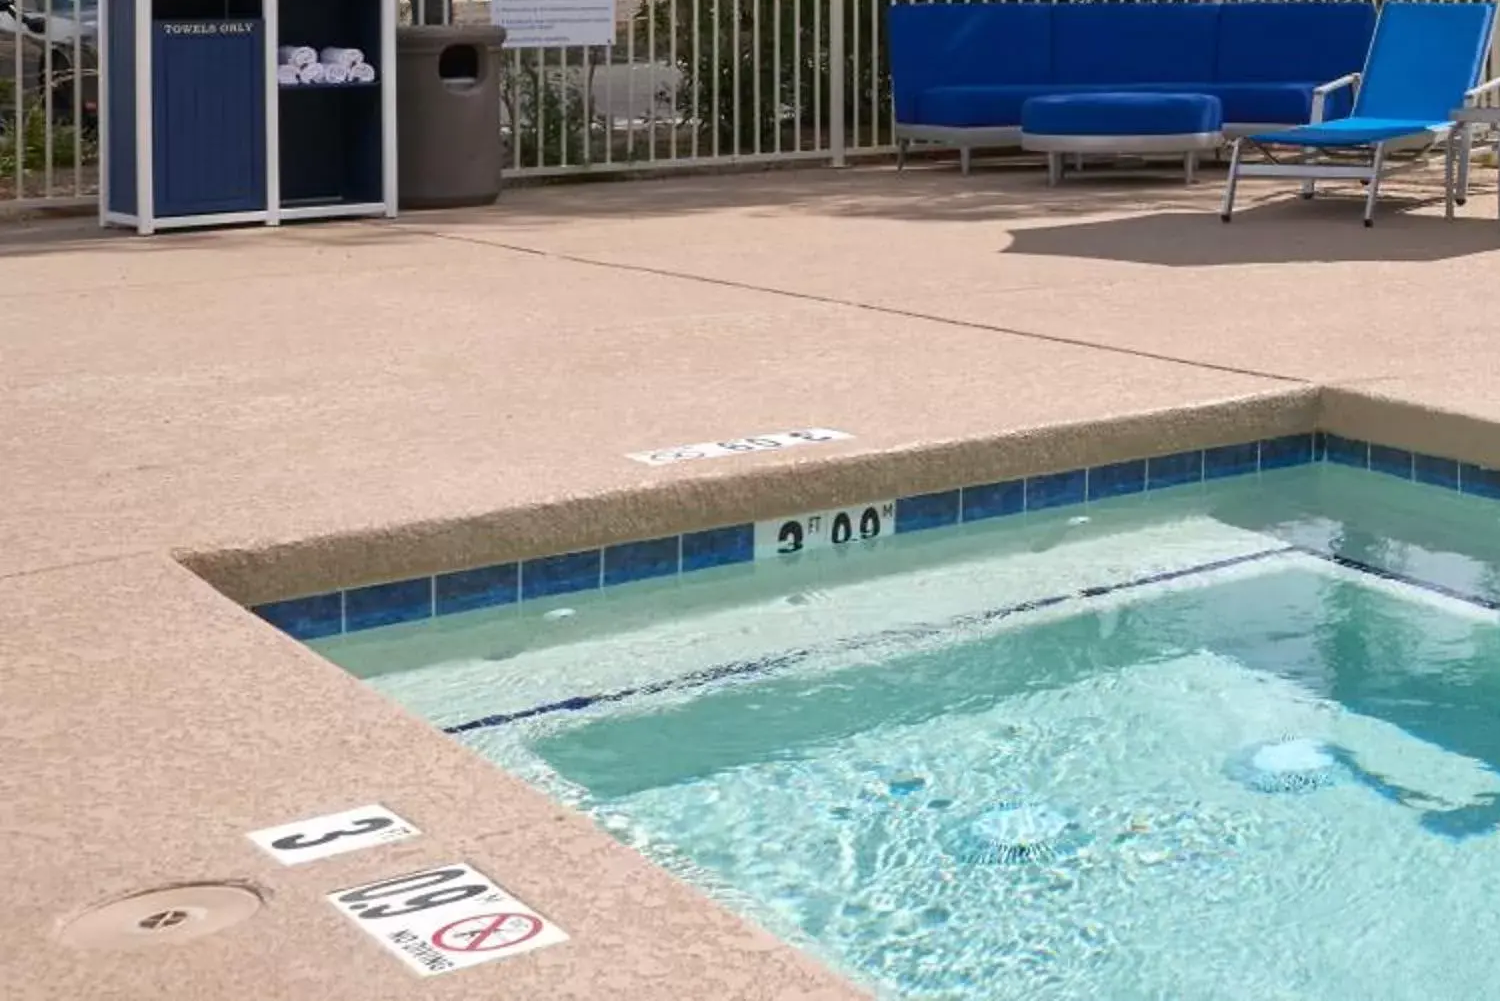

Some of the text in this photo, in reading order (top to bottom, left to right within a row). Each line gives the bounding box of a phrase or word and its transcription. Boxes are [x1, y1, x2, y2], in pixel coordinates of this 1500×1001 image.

[163, 22, 253, 35] TOWELS ONLY
[271, 817, 394, 850] 3
